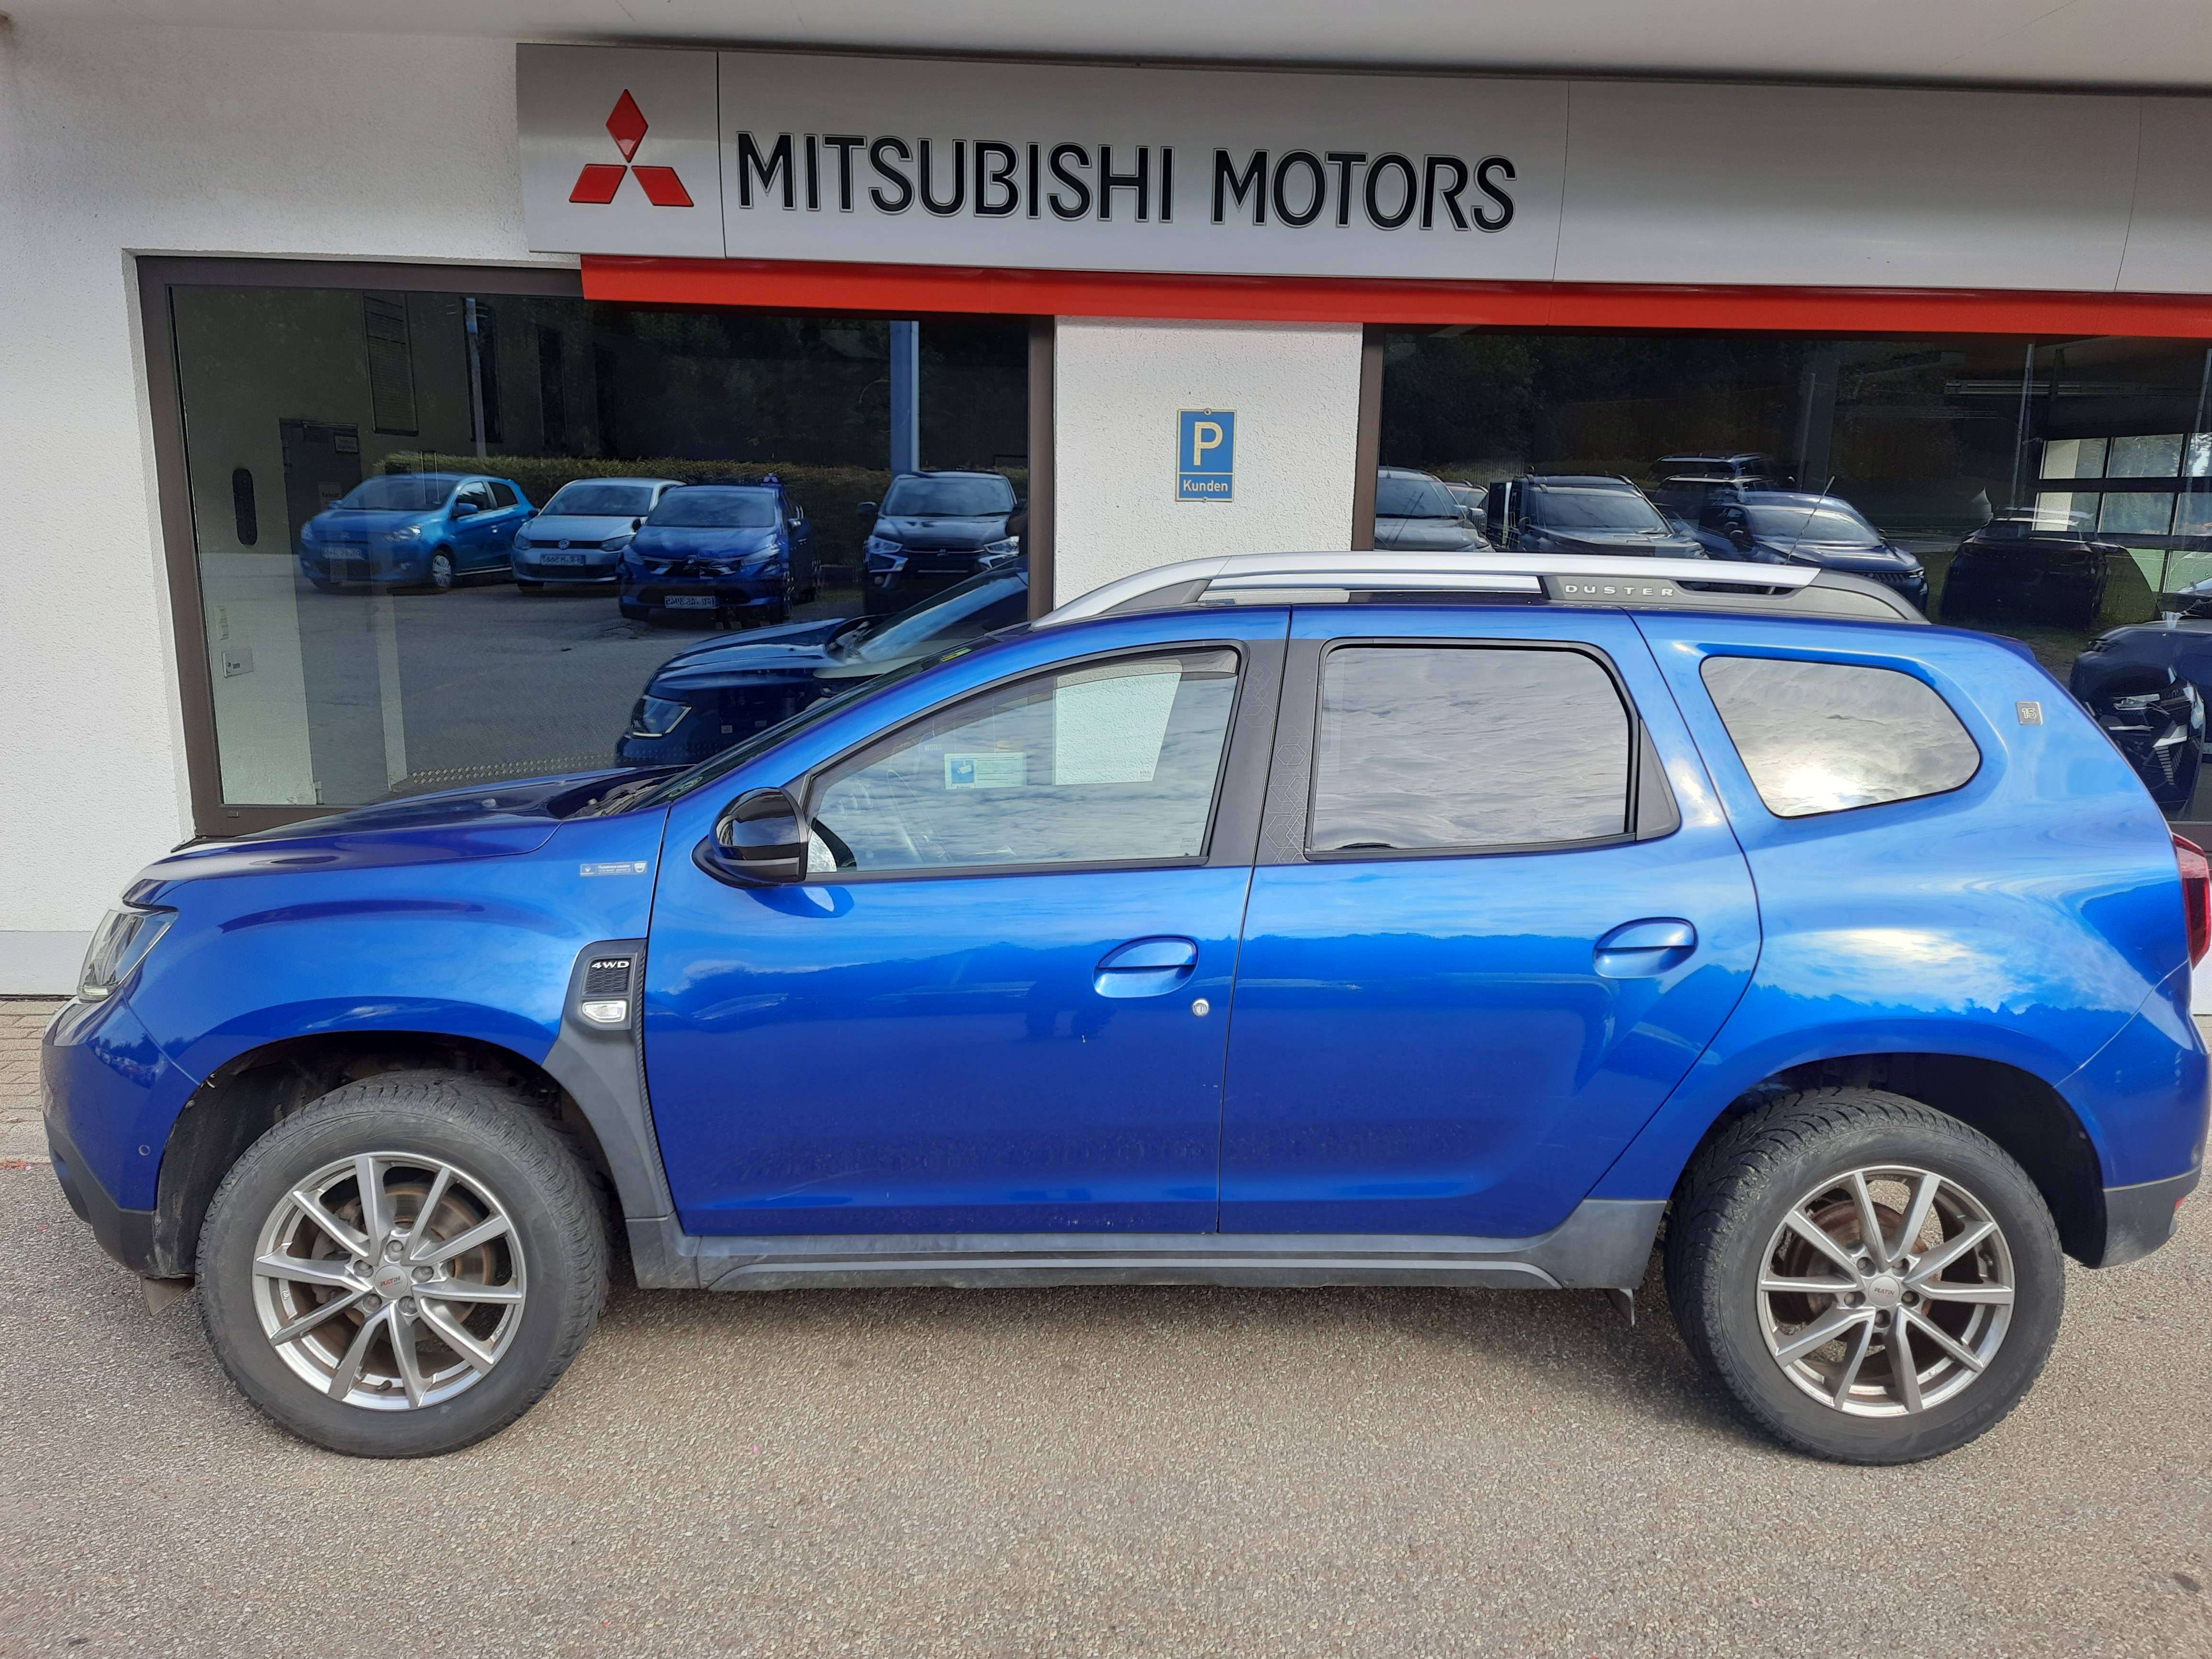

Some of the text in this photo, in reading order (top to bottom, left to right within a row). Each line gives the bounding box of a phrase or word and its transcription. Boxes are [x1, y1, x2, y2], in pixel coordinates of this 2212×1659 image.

[736, 131, 1517, 233] MITSUBISHI MOTORS
[1194, 421, 1223, 466] P
[1183, 479, 1228, 492] Kunden
[1565, 585, 1673, 597] DUSTER
[2022, 708, 2036, 719] 15
[591, 961, 630, 969] 4WD
